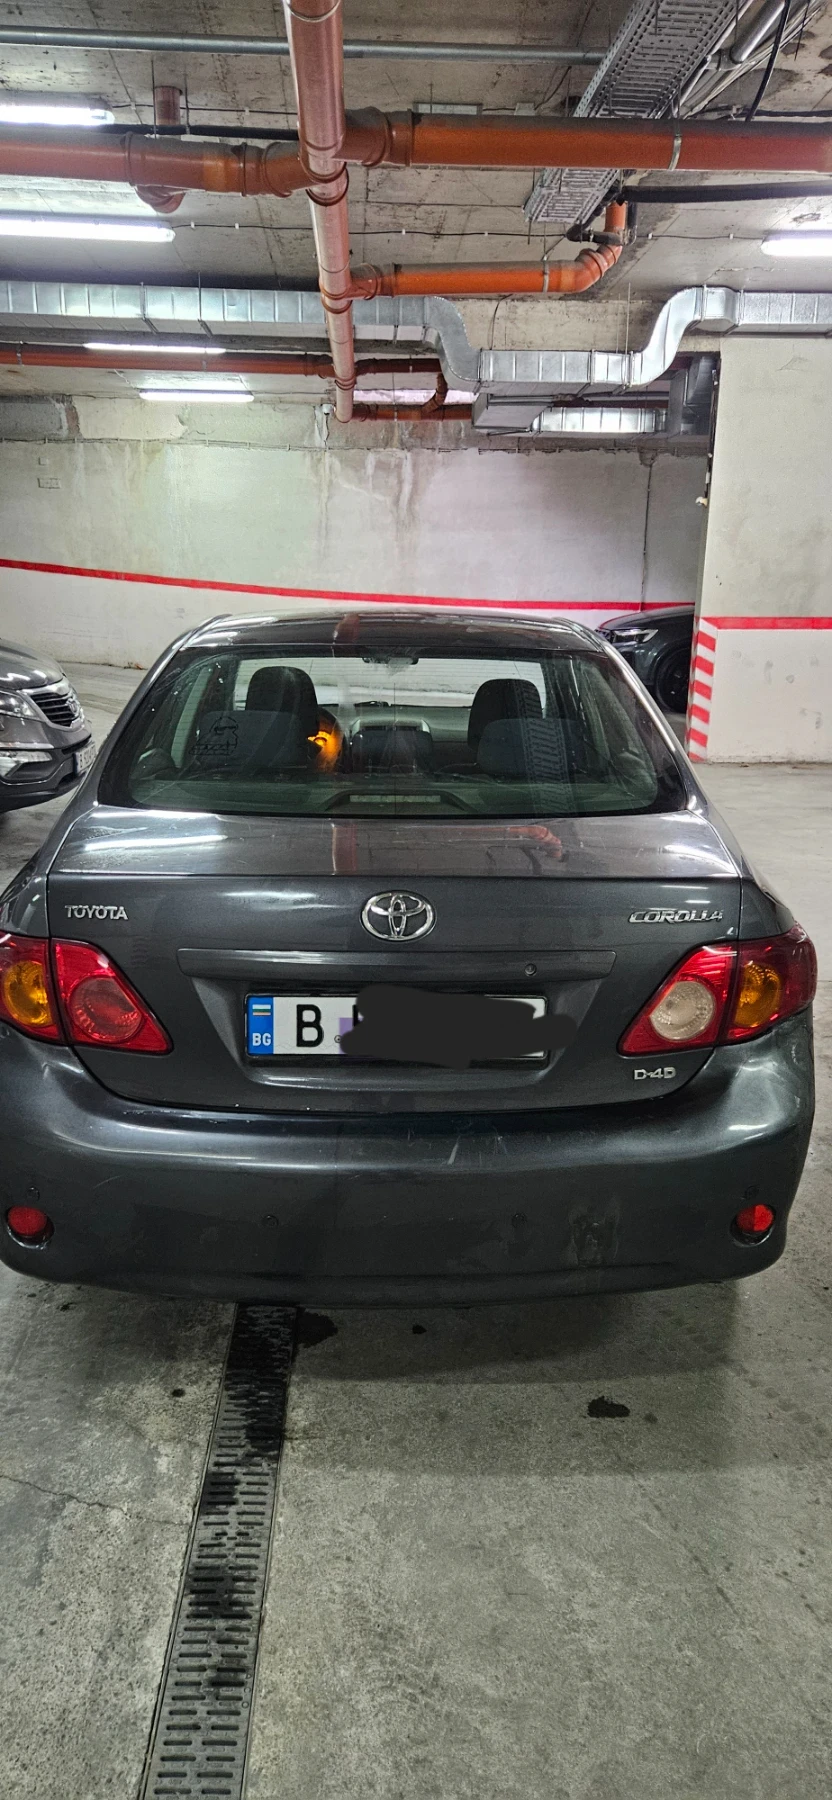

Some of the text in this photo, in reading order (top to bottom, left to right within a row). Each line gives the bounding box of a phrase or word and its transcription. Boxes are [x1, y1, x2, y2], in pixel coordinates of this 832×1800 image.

[64, 905, 129, 920] TOYOTA
[629, 909, 724, 924] COROLLA
[296, 1004, 324, 1047] B
[252, 1032, 272, 1047] BG
[634, 1066, 676, 1080] D-4D
